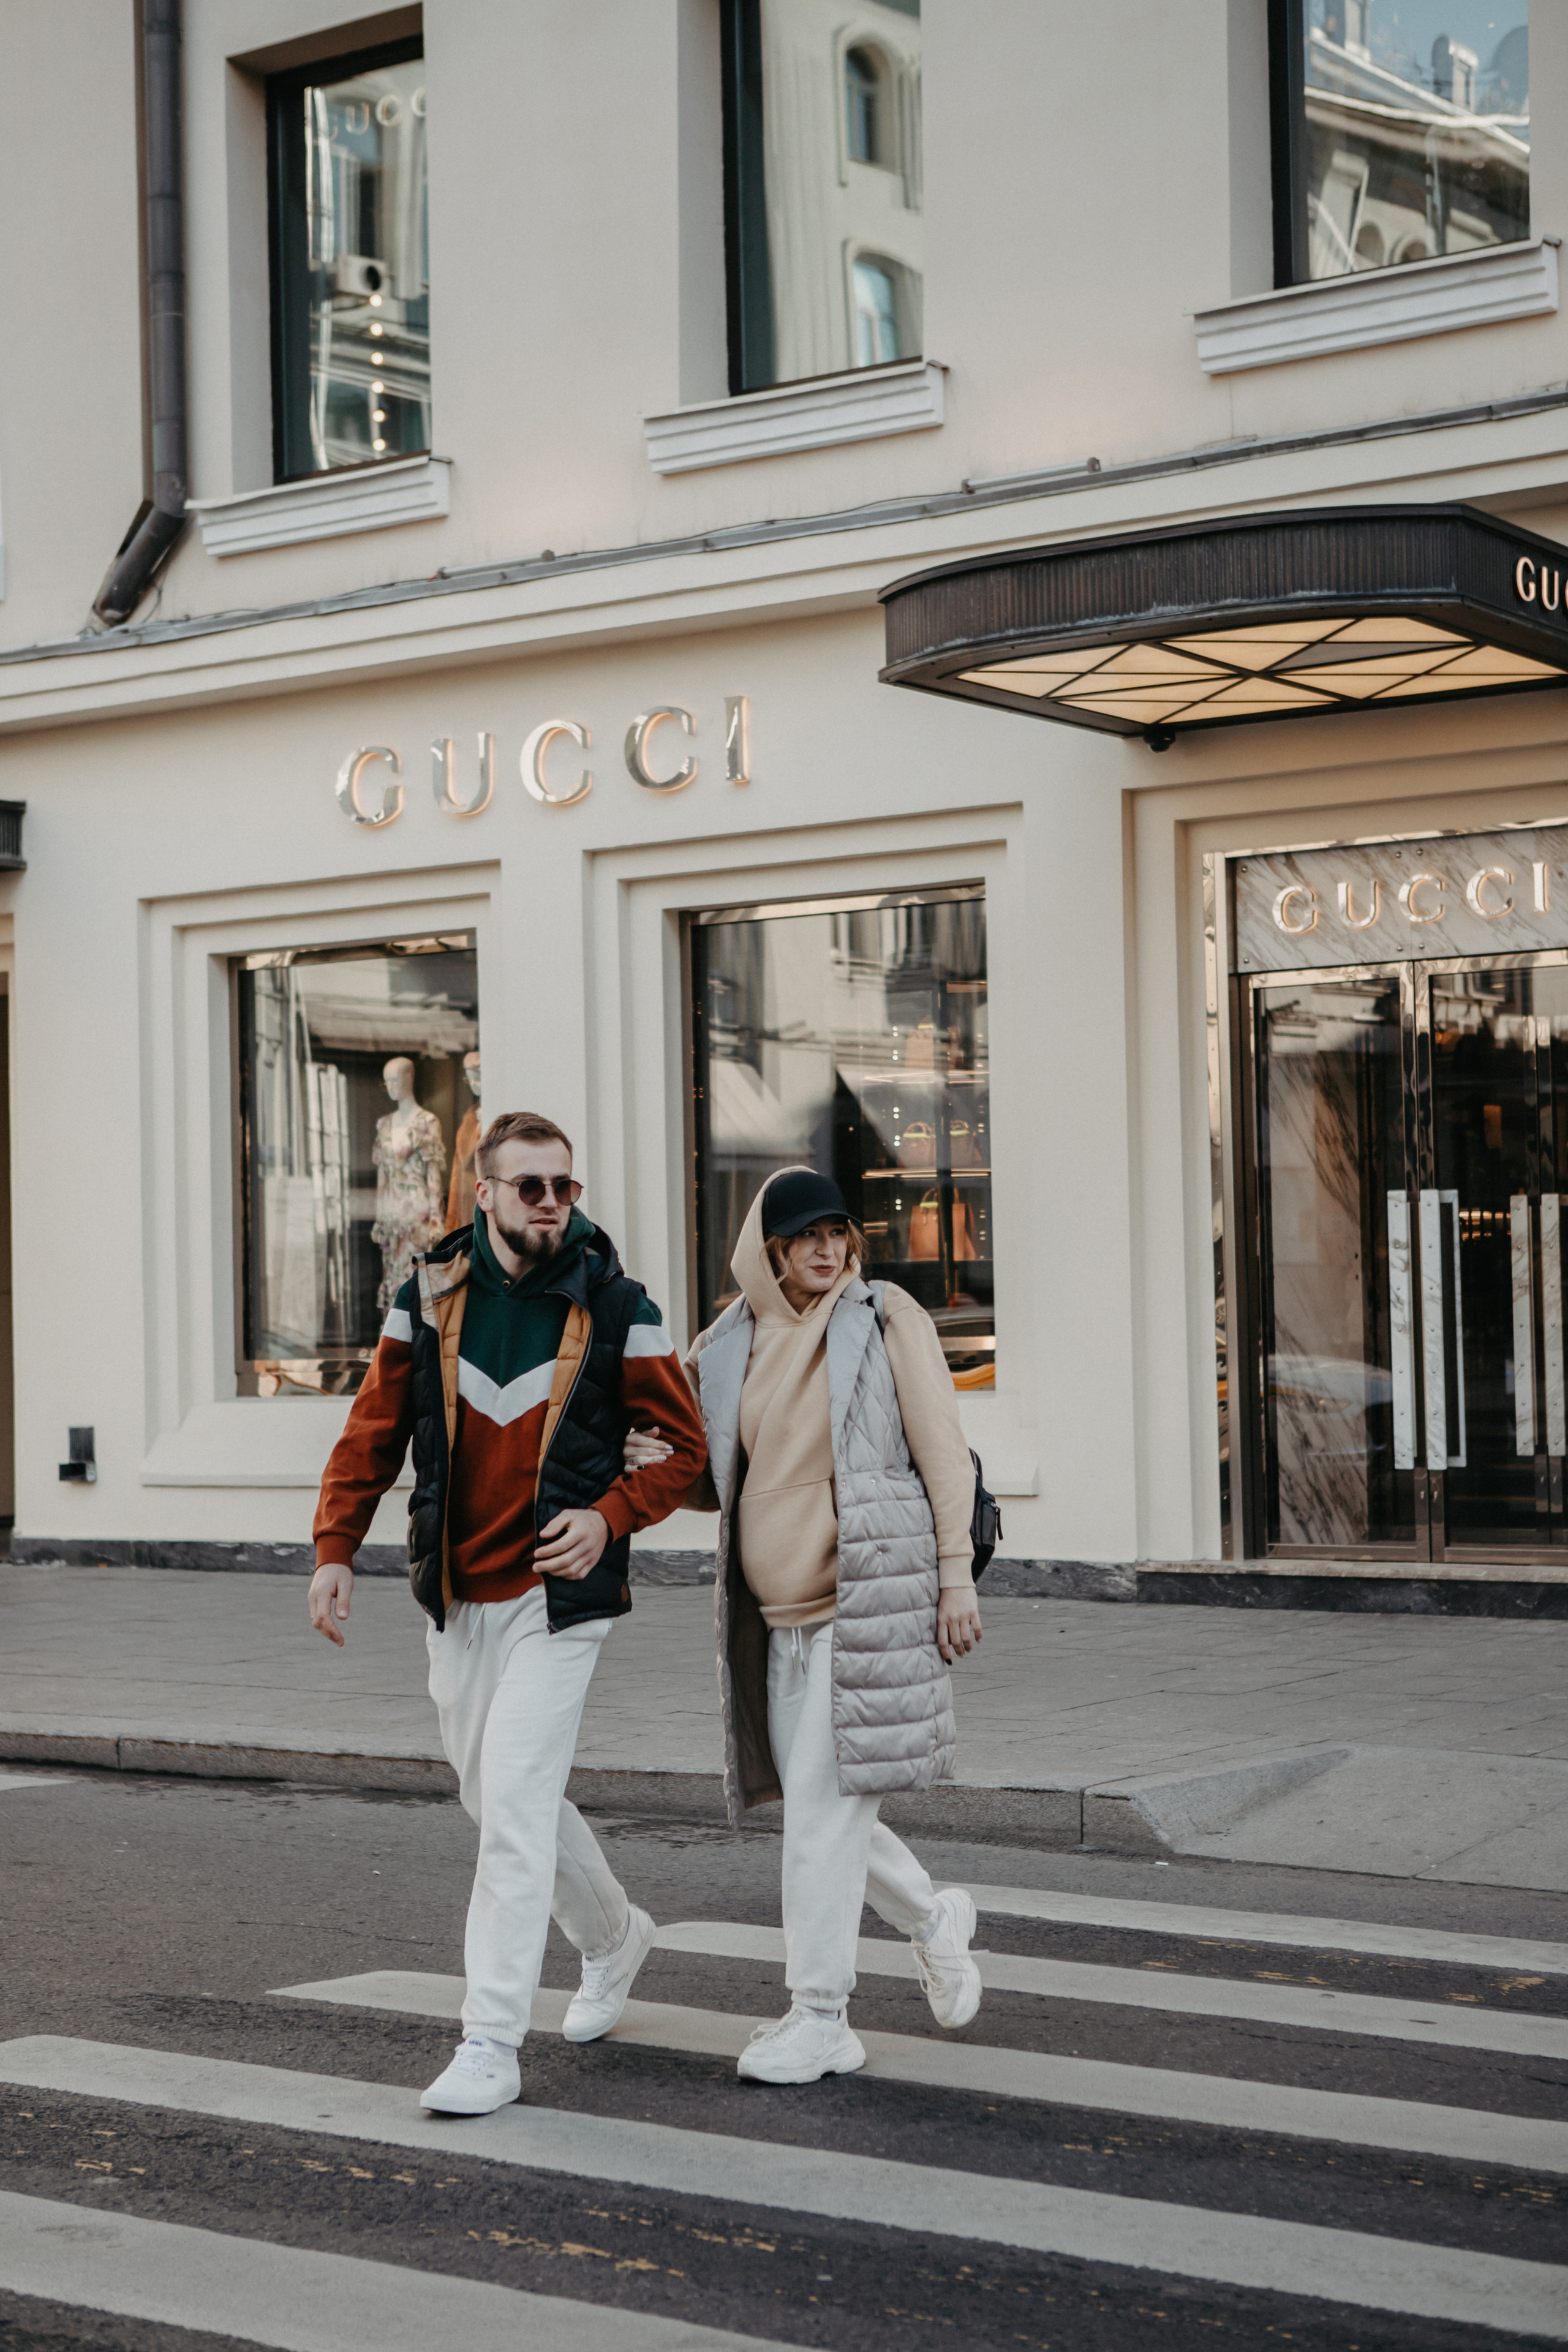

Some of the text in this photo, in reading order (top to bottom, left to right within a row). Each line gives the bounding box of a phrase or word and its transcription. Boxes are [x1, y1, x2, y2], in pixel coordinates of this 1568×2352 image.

[1516, 556, 1568, 611] GU
[335, 695, 750, 826] GUCCI
[1272, 862, 1548, 934] GUCCI
